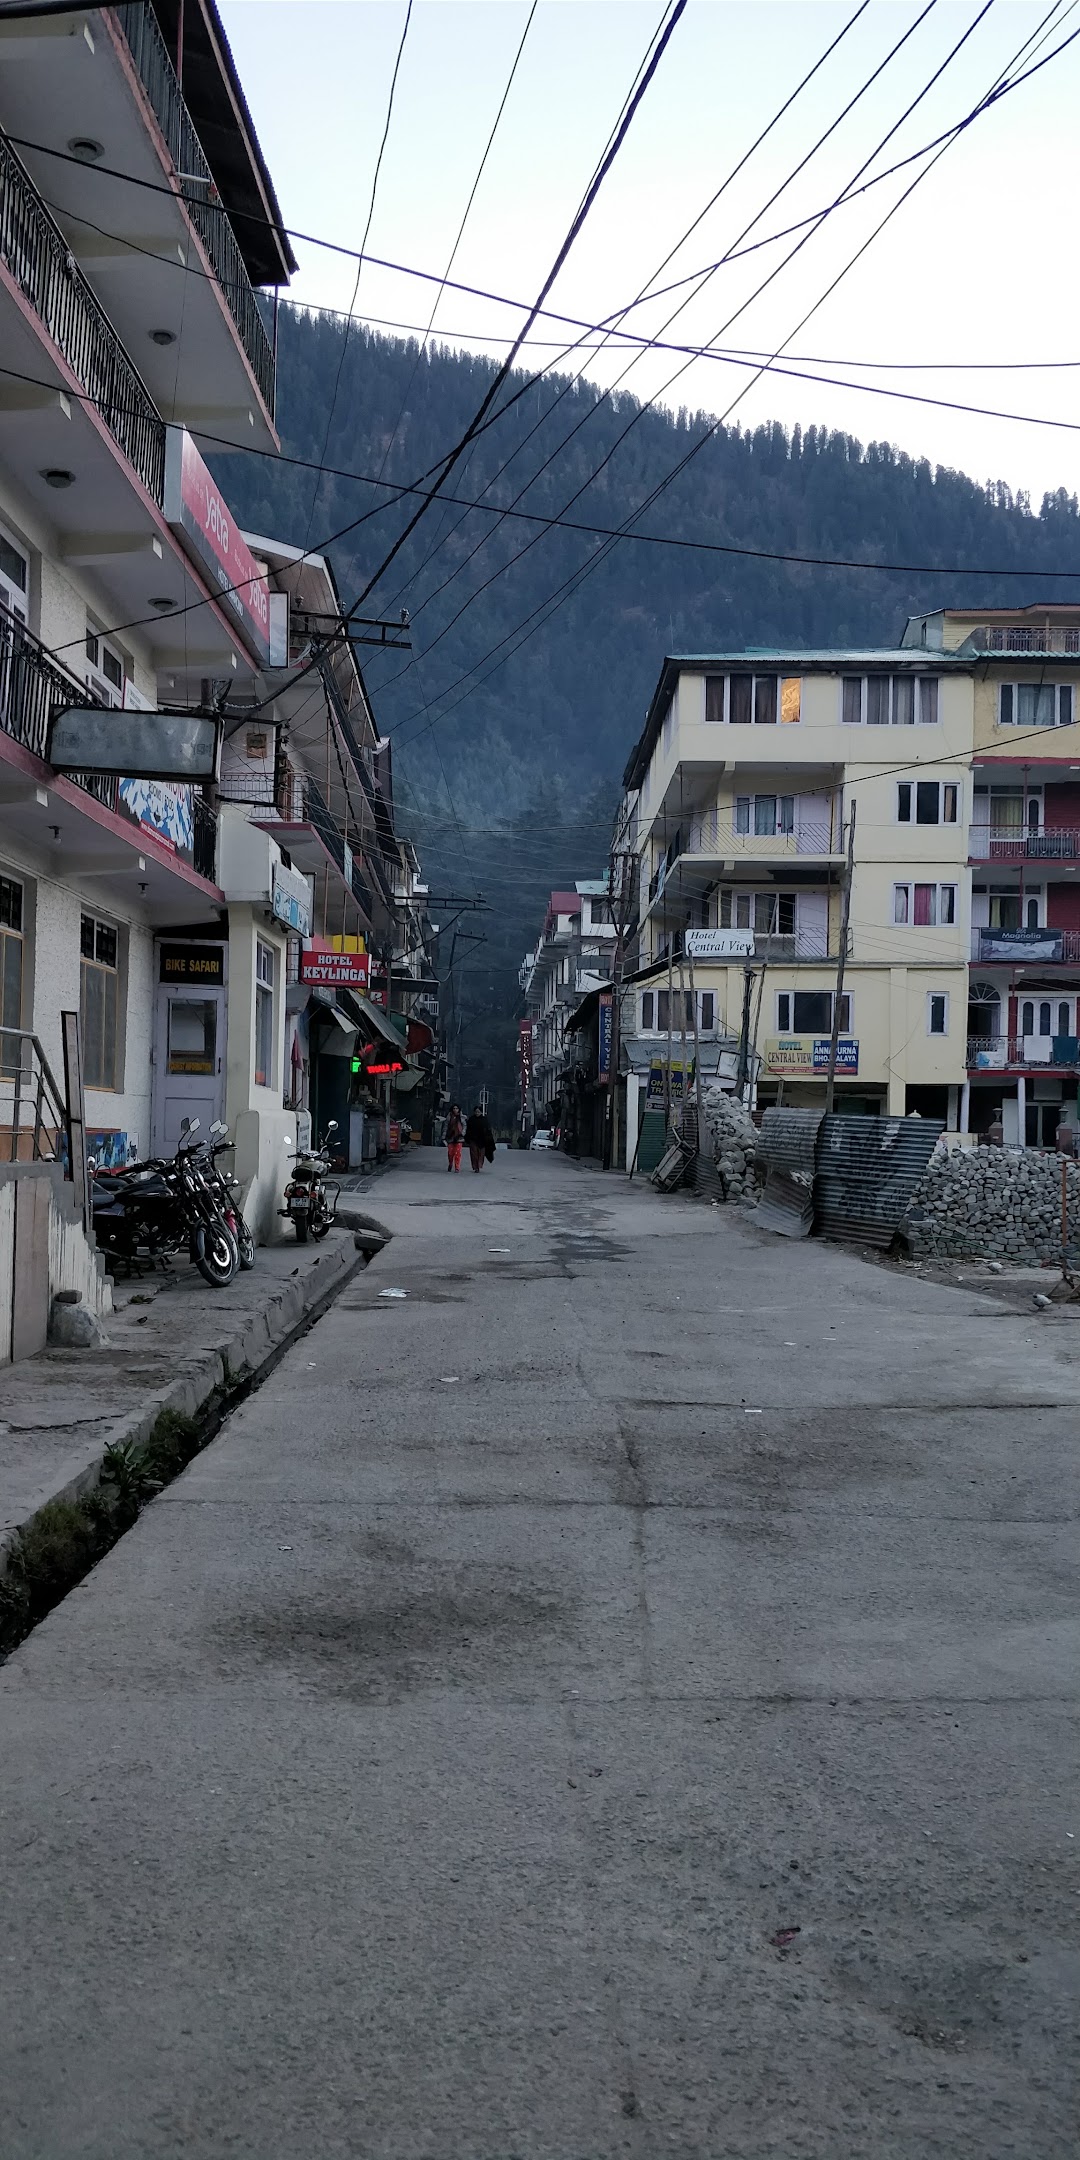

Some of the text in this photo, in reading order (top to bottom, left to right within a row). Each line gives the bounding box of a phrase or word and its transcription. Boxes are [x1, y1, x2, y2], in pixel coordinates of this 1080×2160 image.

[205, 486, 230, 554] yatra
[690, 931, 717, 940] Hotel
[1001, 932, 1042, 941] Magnolia
[687, 940, 754, 952] Central View
[165, 959, 219, 973] BIKE SAFARI
[317, 955, 353, 966] HOTEL
[303, 966, 366, 982] KEYLINGA
[604, 1007, 613, 1044] CENTRAL
[778, 1041, 803, 1051] HOTEL
[814, 1046, 857, 1055] ANNURNA
[767, 1052, 812, 1063] CENTRAL VIEW
